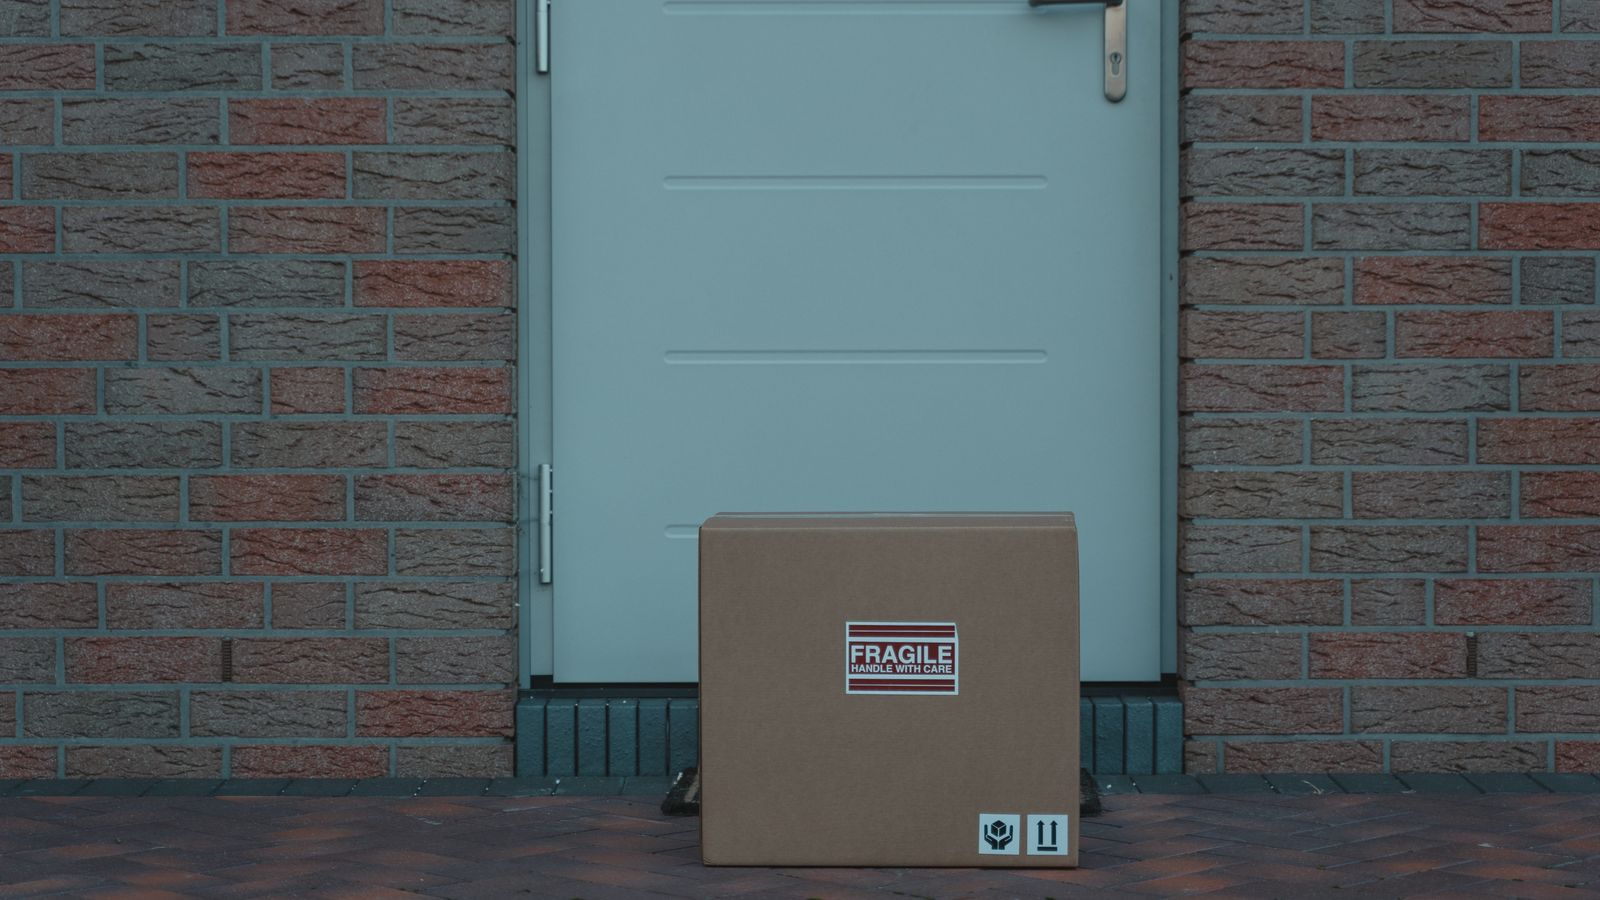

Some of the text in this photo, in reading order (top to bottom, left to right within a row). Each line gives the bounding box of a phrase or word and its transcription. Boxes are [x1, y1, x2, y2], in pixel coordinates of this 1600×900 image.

[851, 645, 952, 664] FRAGILE
[851, 664, 952, 674] HANDLE WITH CARE
